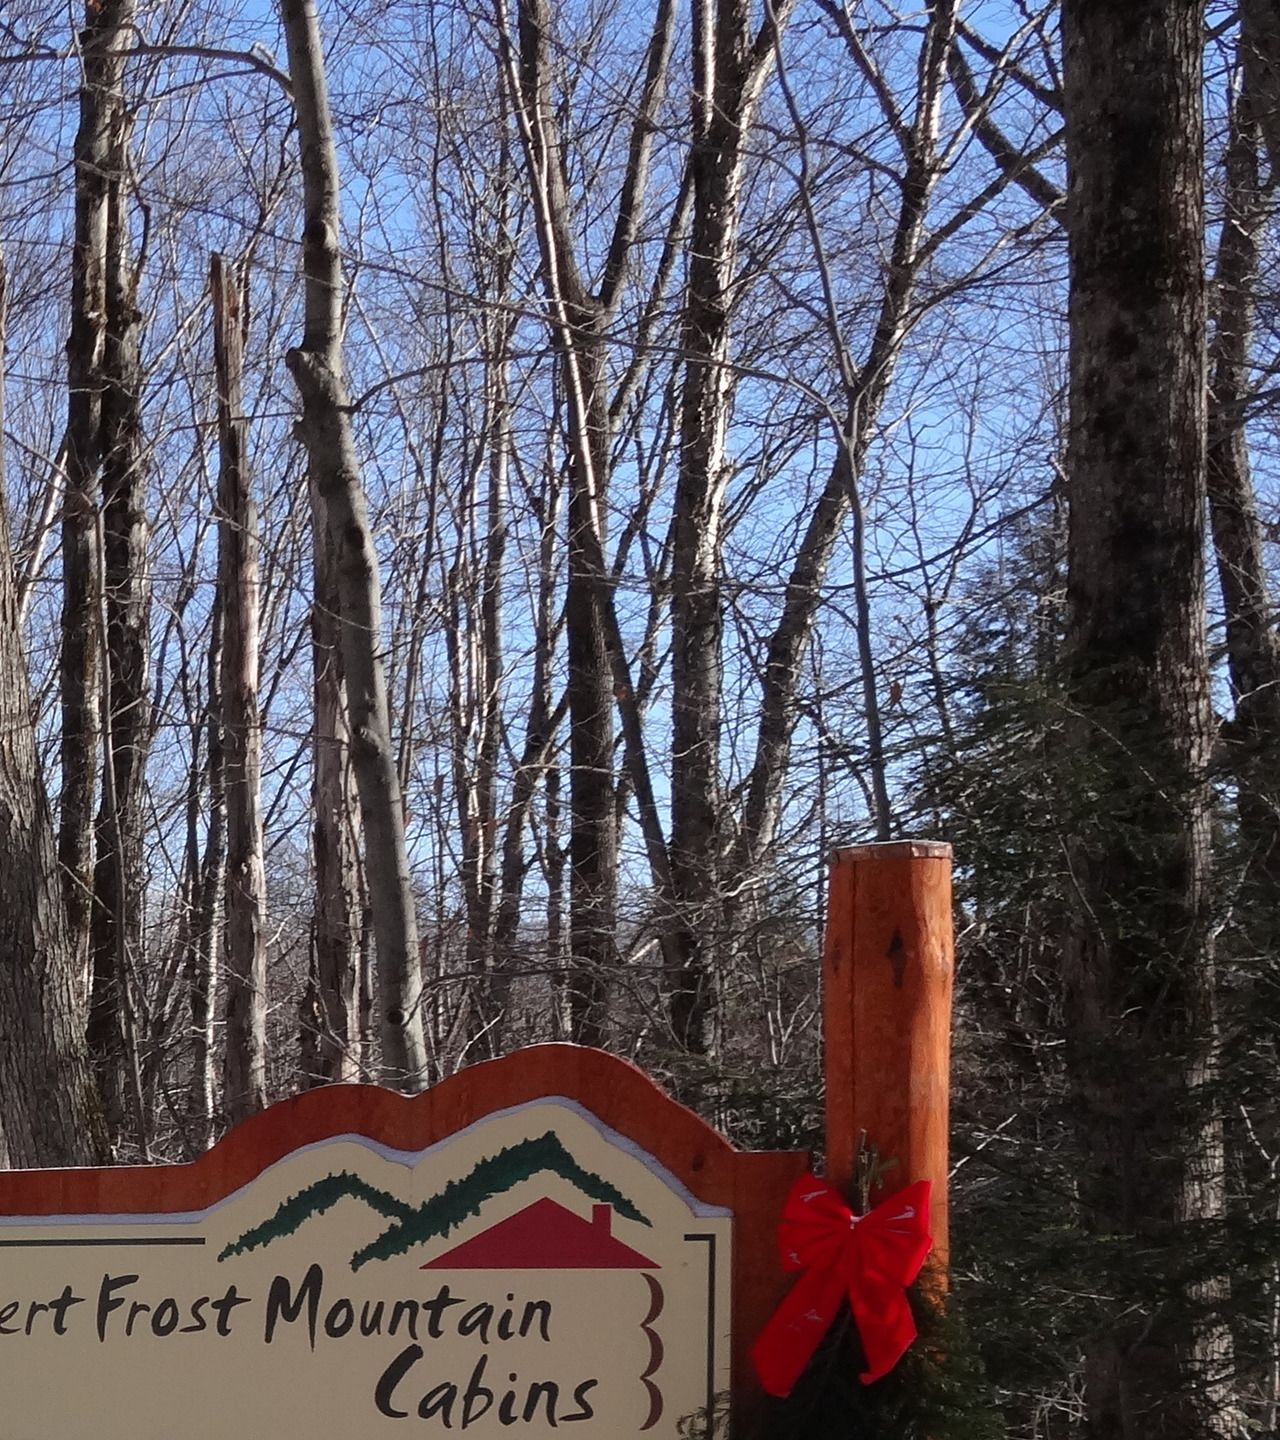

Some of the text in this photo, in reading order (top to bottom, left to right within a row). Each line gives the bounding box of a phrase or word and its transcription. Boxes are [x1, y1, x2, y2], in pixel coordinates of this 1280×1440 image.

[97, 1273, 251, 1344] Frost
[265, 1263, 552, 1352] Mountain
[374, 1343, 599, 1430] Cabins
